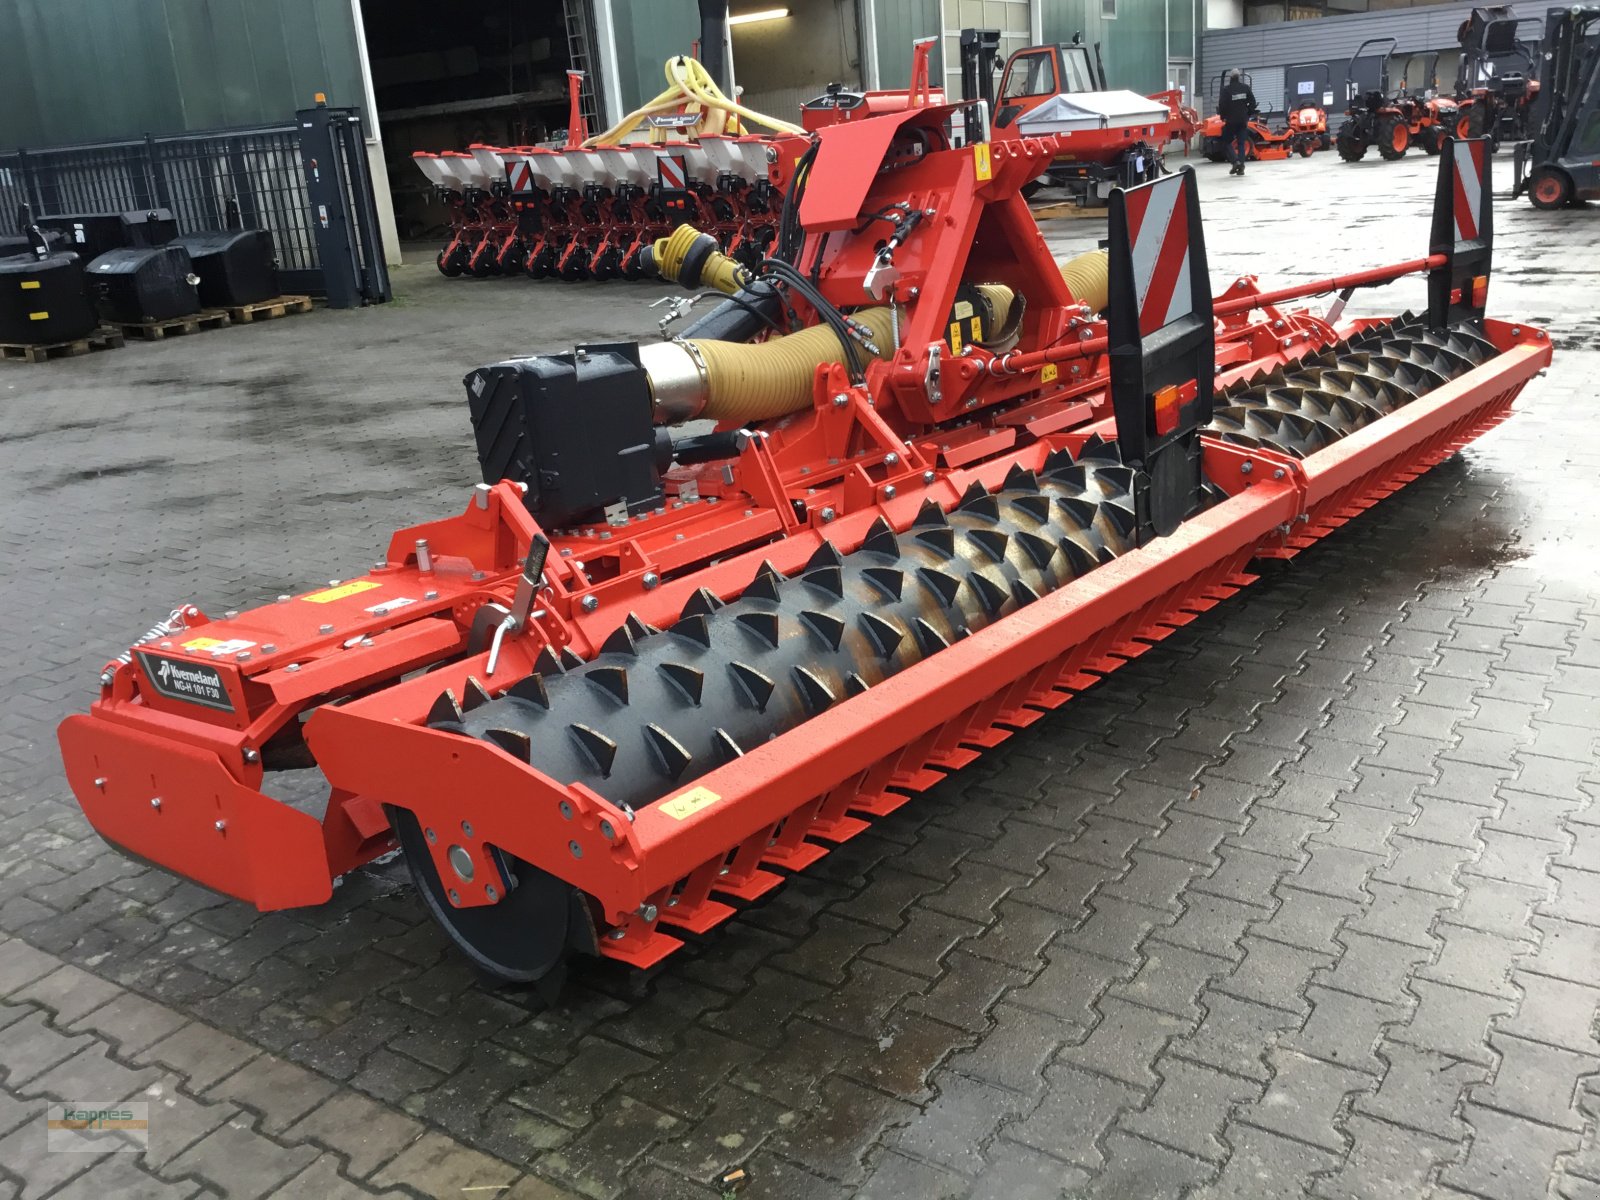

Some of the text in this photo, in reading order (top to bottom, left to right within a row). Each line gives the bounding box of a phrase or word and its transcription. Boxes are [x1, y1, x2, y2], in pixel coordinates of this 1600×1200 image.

[170, 664, 220, 687] Kverneland
[174, 679, 220, 699] NG-H 101 F30
